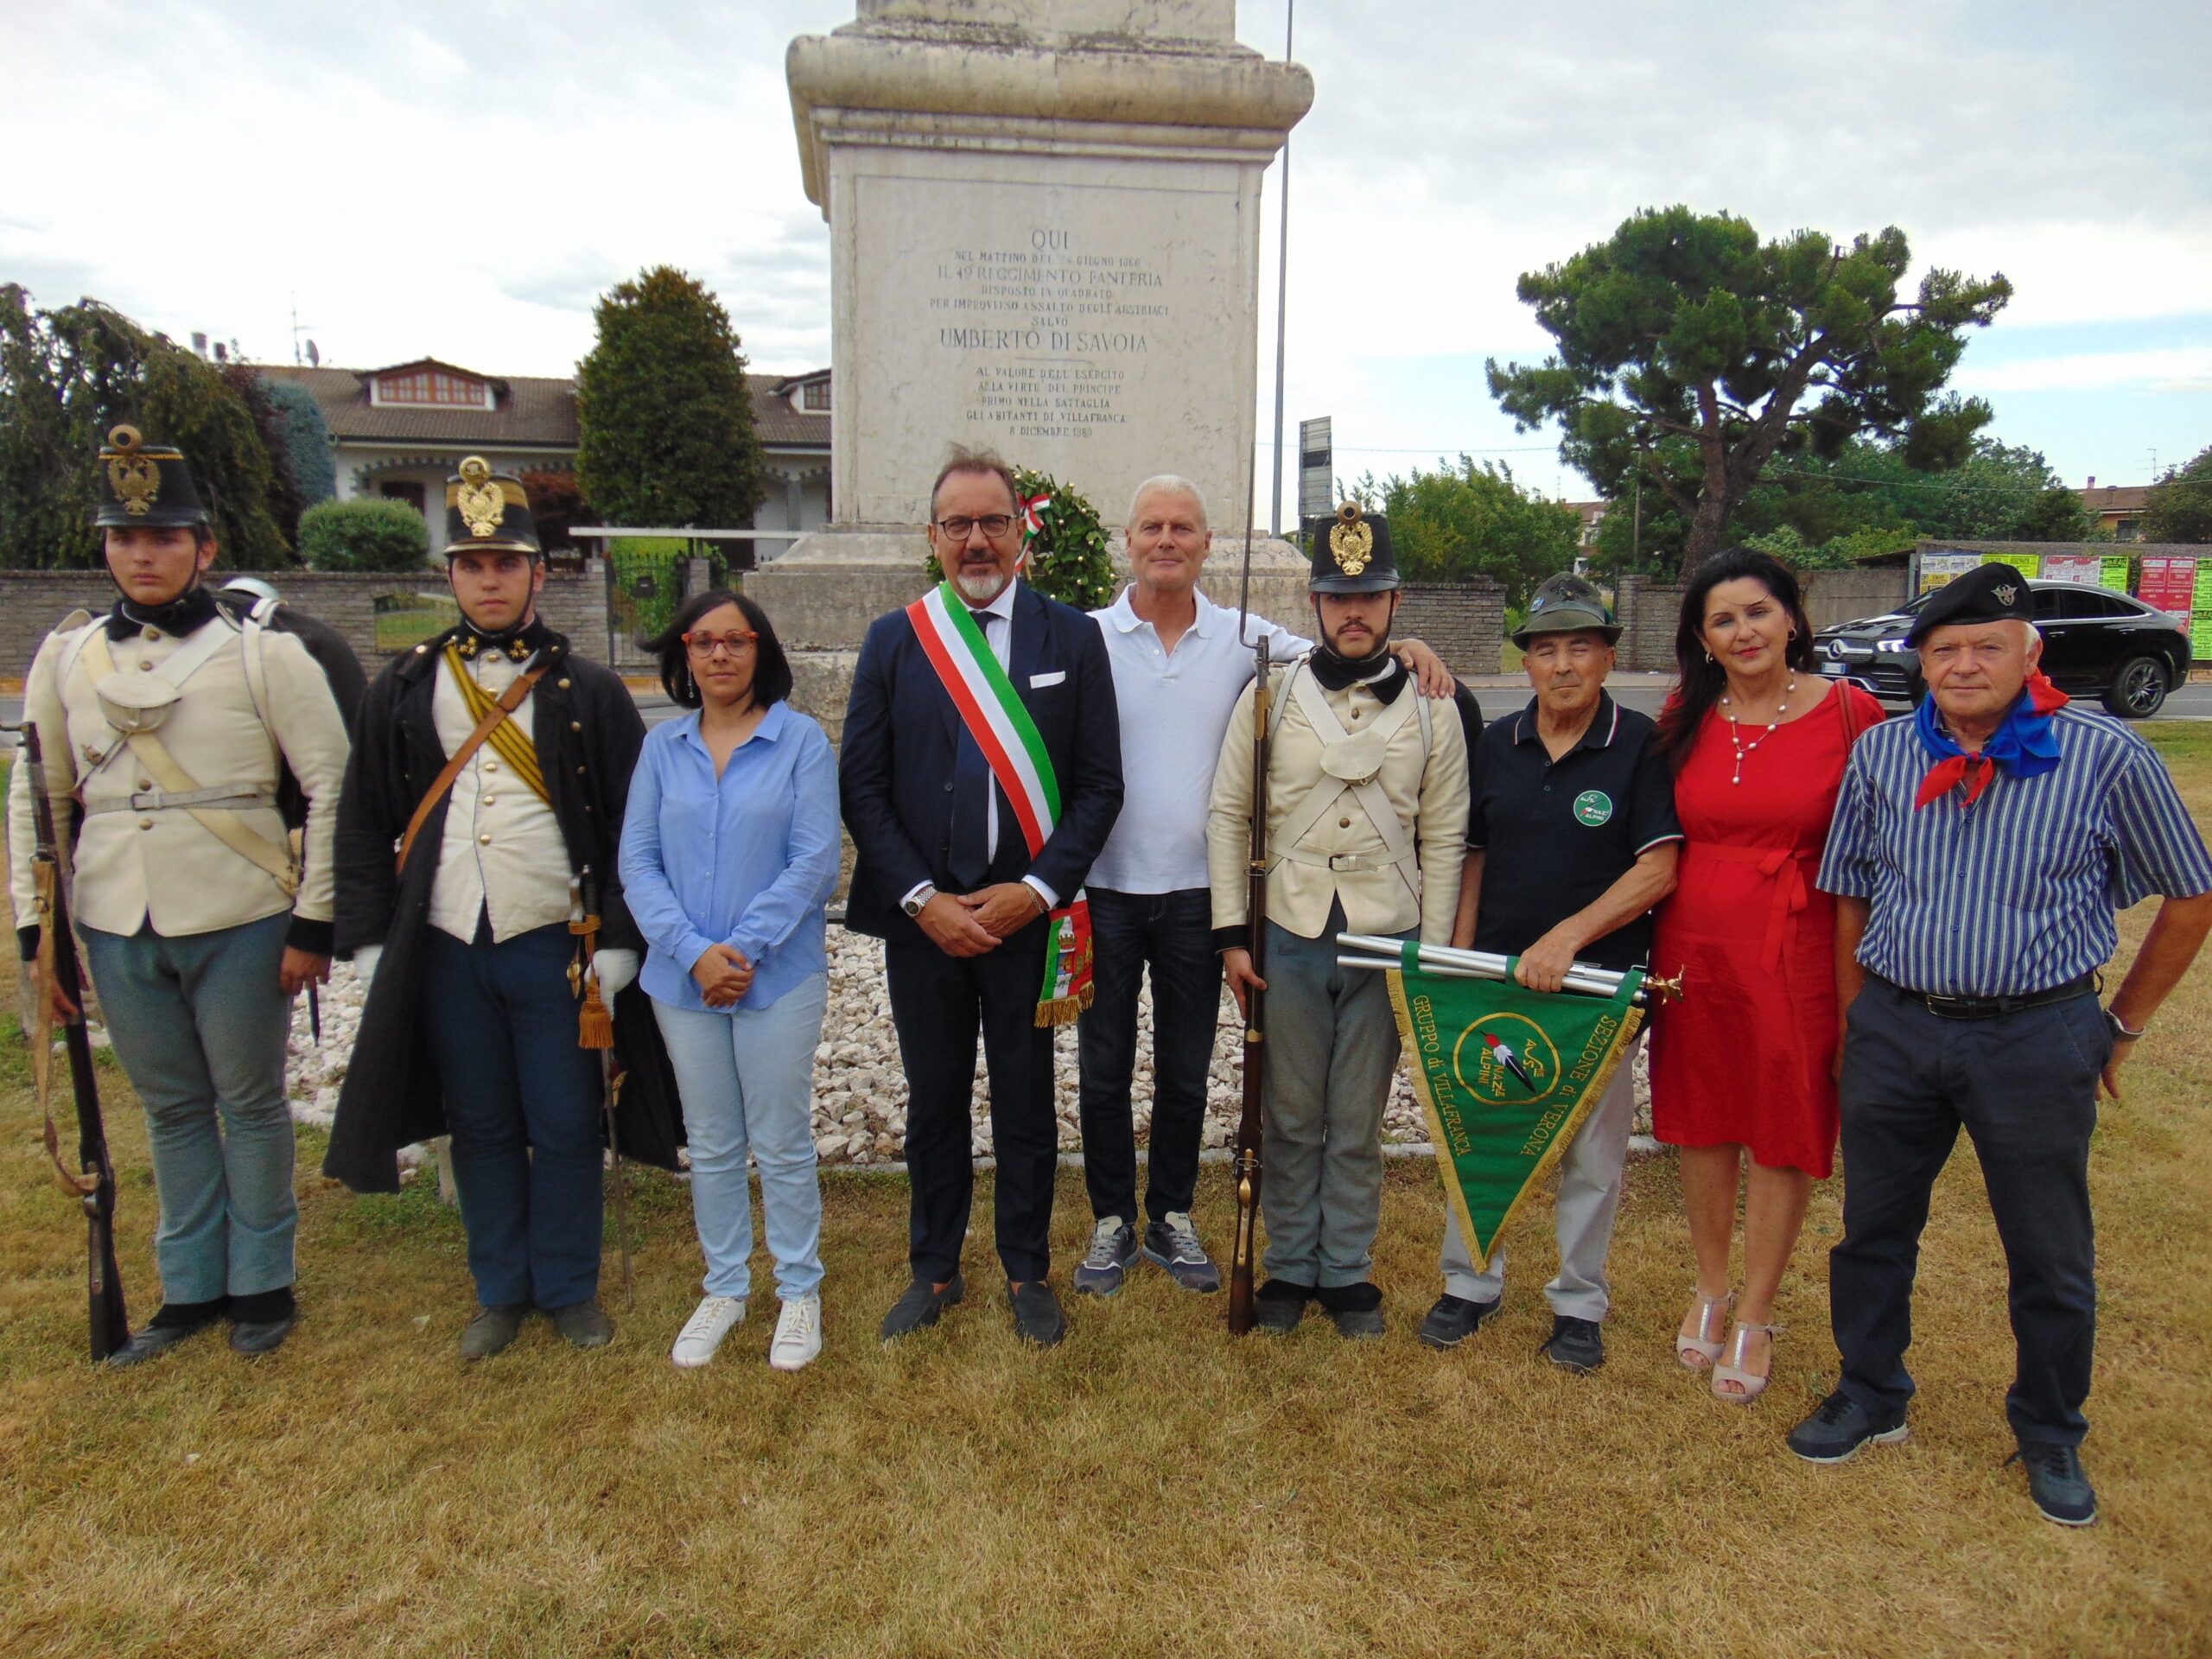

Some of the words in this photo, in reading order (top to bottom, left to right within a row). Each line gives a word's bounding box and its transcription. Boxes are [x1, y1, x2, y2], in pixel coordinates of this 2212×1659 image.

[1031, 229, 1068, 251] QUI
[955, 251, 974, 261] NEL
[980, 251, 1027, 264] MATTINO
[1077, 255, 1115, 266] GIUGNO
[938, 264, 953, 279] IL
[977, 266, 1082, 284] REGGIMENTO
[1090, 270, 1163, 288] FANTERIA
[982, 285, 1037, 297] DISPOSTO
[1040, 287, 1052, 297] IN
[1057, 288, 1113, 300] QUADRATO
[930, 297, 950, 309] PER
[1023, 302, 1074, 313] ASSALTO
[940, 327, 1041, 351] UMBERTO
[1051, 331, 1070, 351] DI
[1076, 331, 1147, 353] SAVOIA
[976, 366, 992, 378] AL
[995, 366, 1036, 378] VALORE
[978, 382, 1004, 392] ALLA
[1048, 383, 1069, 394] DEL
[1072, 384, 1122, 395] PRINCIPE
[982, 396, 1013, 407] PRIMO
[1018, 397, 1049, 408] NELLA
[1055, 398, 1110, 410] BATTAGLIA
[966, 410, 984, 422] GLI
[988, 410, 1039, 422] ABITANTI
[1043, 411, 1054, 423] DI
[1060, 412, 1127, 424] VILLAFRANCA
[1020, 427, 1070, 437] DICEMBRE
[1413, 995, 1440, 1052] GRUPPO
[1569, 1014, 1618, 1081] SEZIONE
[1427, 1057, 1445, 1070] di
[1478, 1047, 1493, 1085] ALPINI
[1559, 1084, 1577, 1098] di
[1433, 1072, 1472, 1157] VILLAFRANCA
[1520, 1104, 1569, 1156] VERONA
